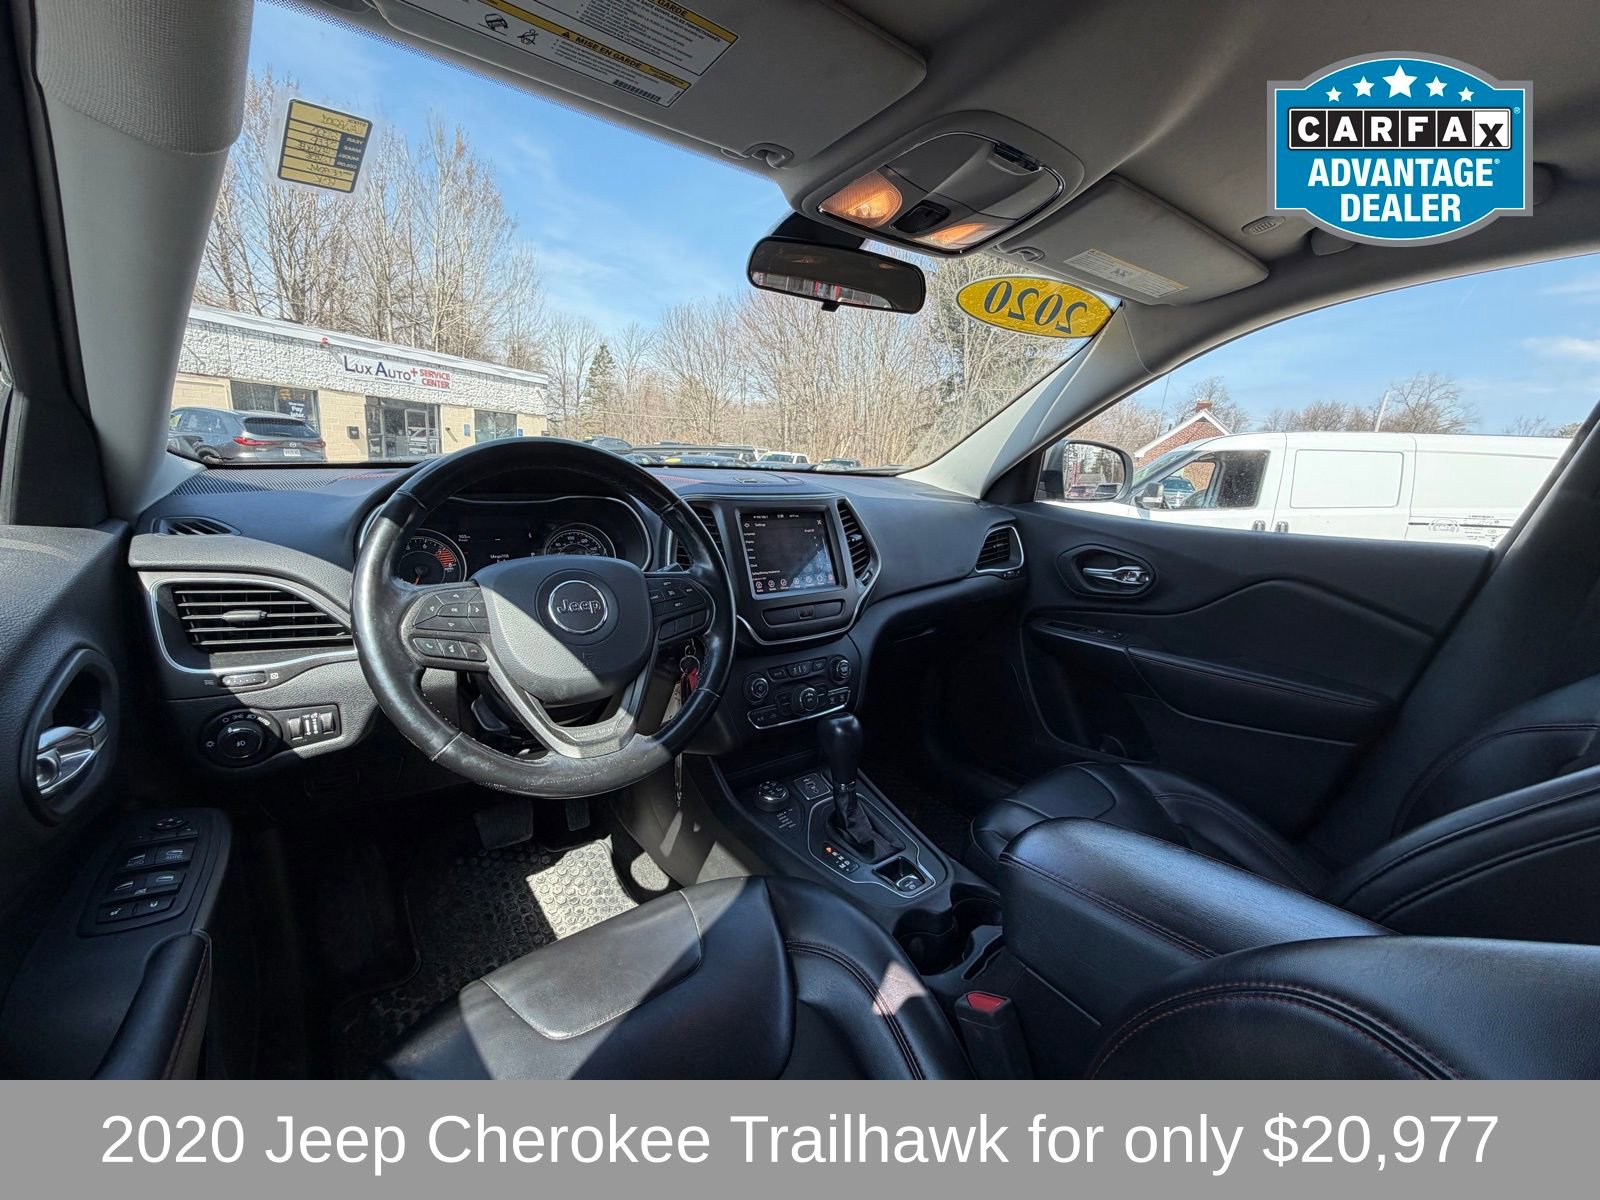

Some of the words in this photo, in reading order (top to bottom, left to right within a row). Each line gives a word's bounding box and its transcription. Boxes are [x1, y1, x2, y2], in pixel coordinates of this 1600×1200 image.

[657, 0, 688, 18] GARDE
[575, 36, 599, 51] MISE
[599, 46, 613, 57] EN
[612, 51, 641, 69] GARDE
[419, 368, 451, 380] SERVICE
[421, 379, 450, 389] CENTER
[556, 599, 601, 614] Jeep
